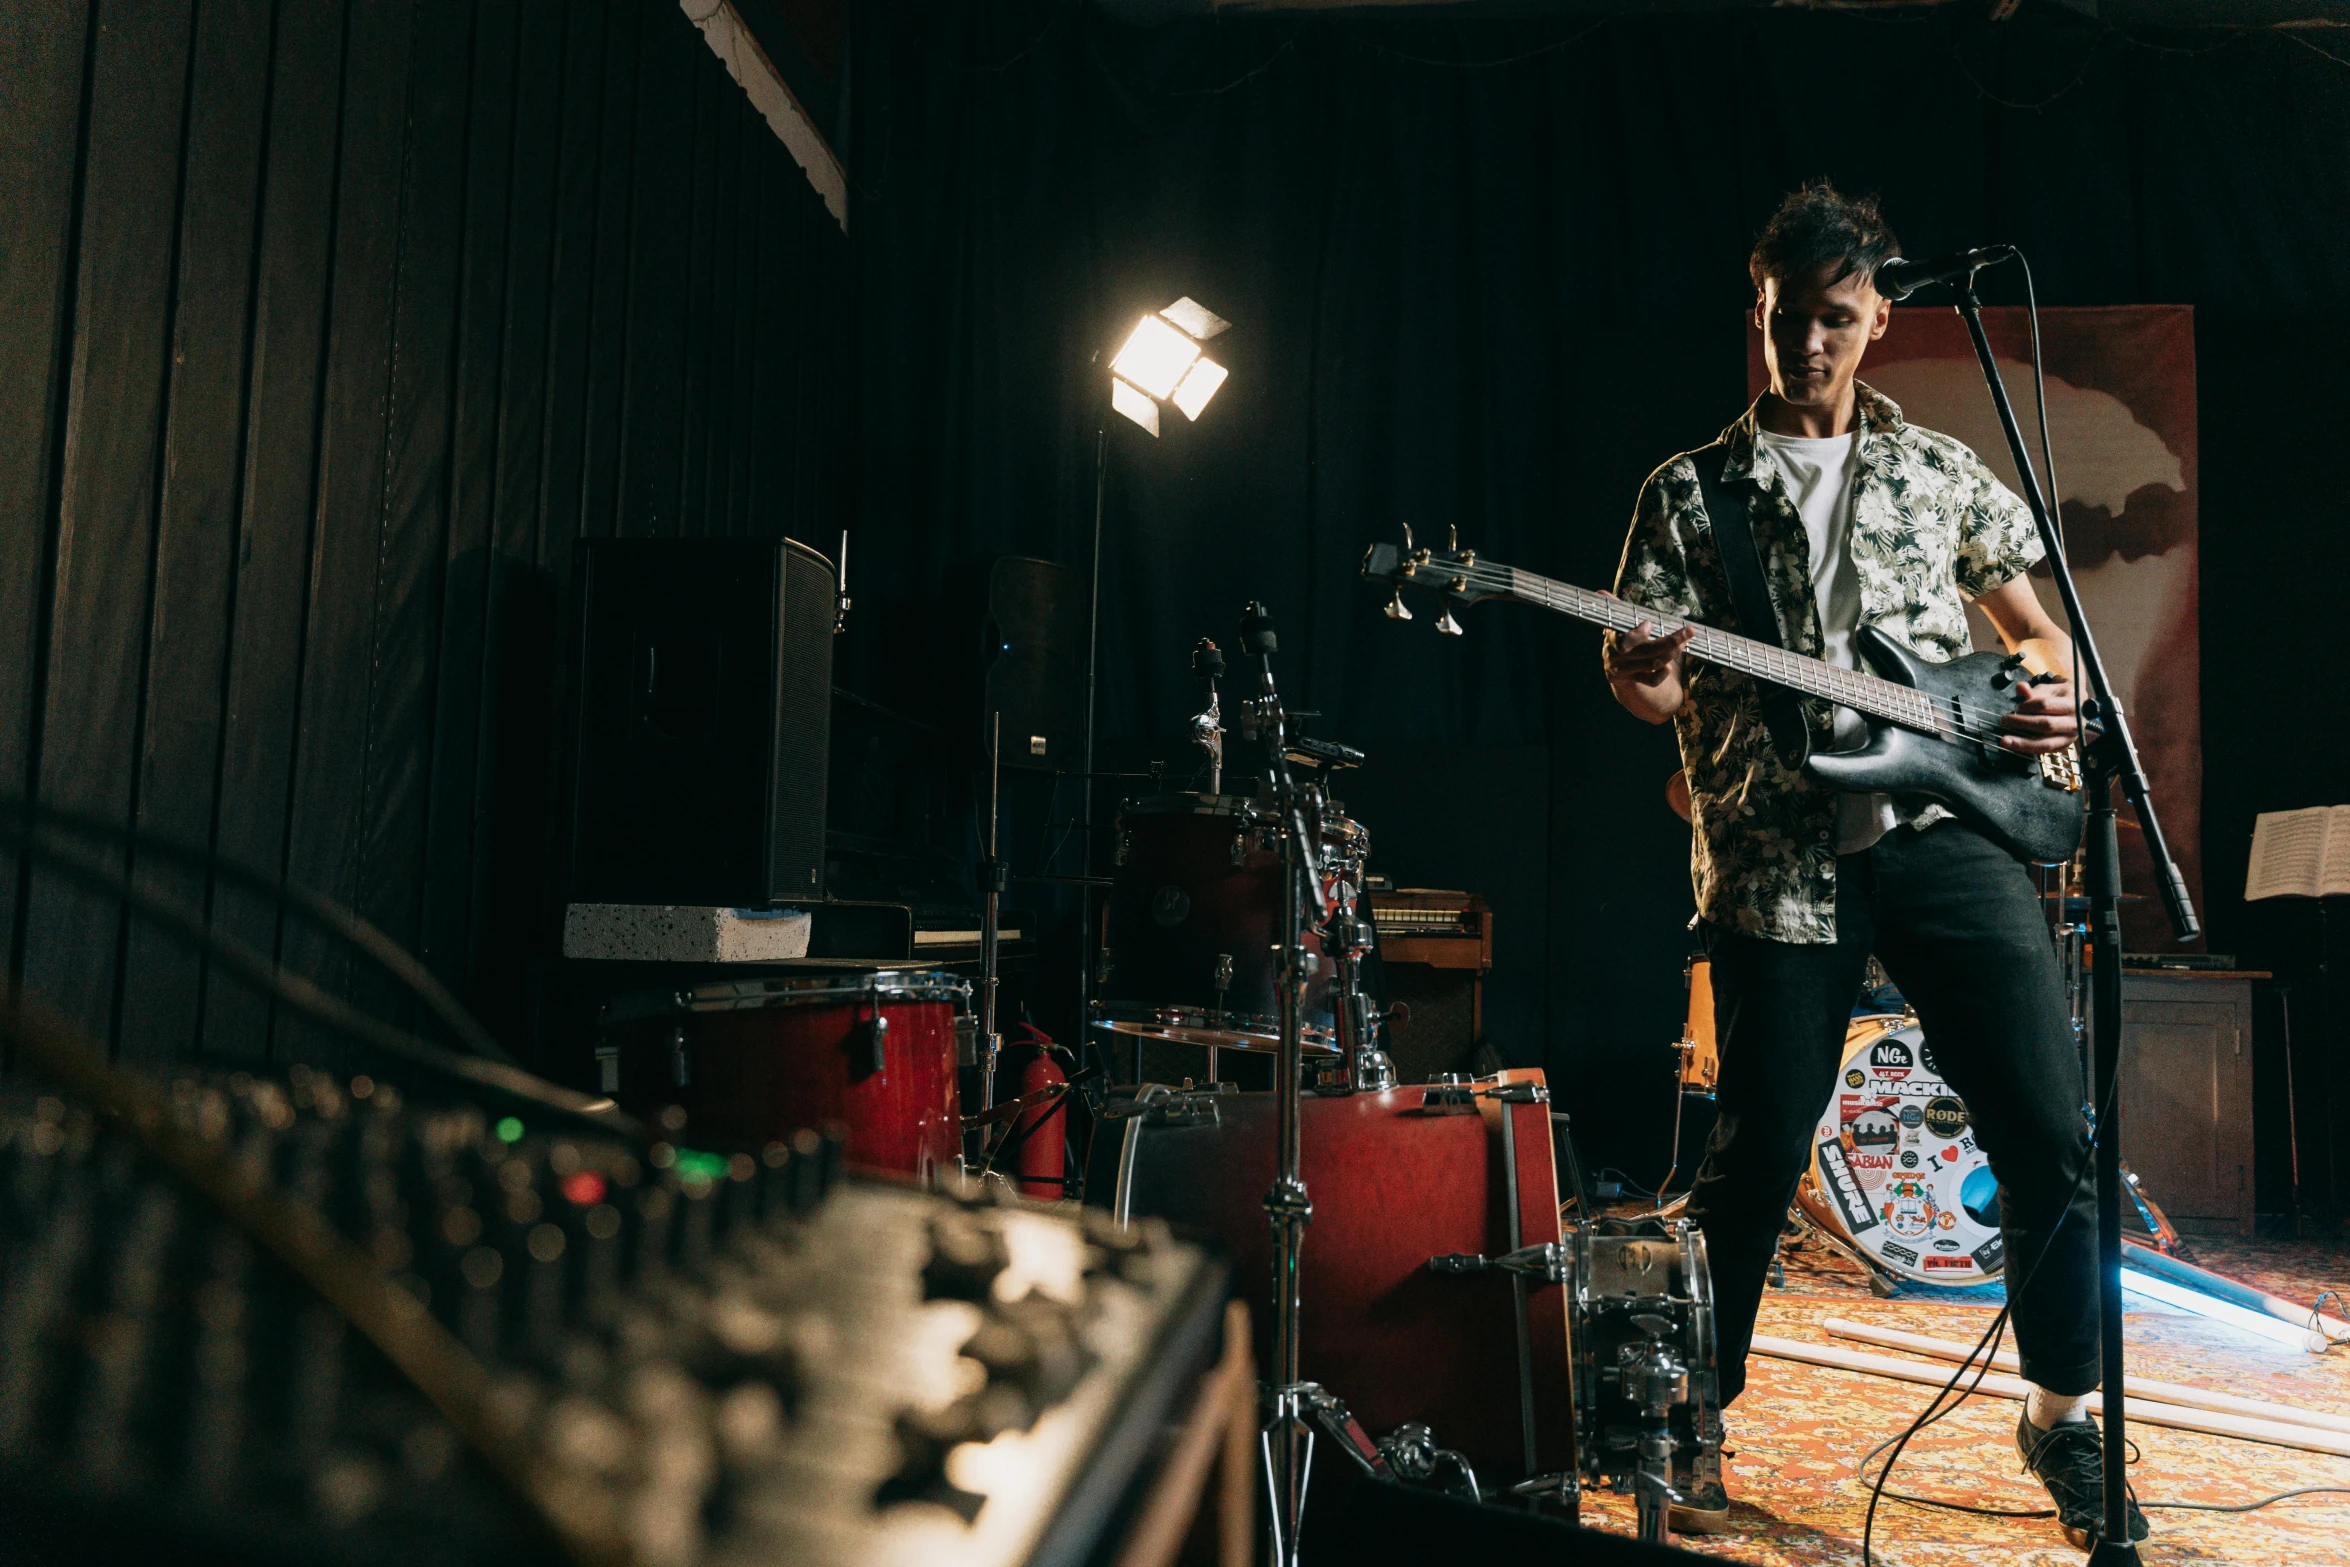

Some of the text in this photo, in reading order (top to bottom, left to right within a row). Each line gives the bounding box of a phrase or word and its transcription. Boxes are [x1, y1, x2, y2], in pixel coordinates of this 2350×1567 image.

[1877, 1045, 1908, 1064] NGe
[1844, 1155, 1893, 1169] SABIAN
[1927, 1155, 1943, 1172] I
[1822, 1144, 1872, 1224] SHURE
